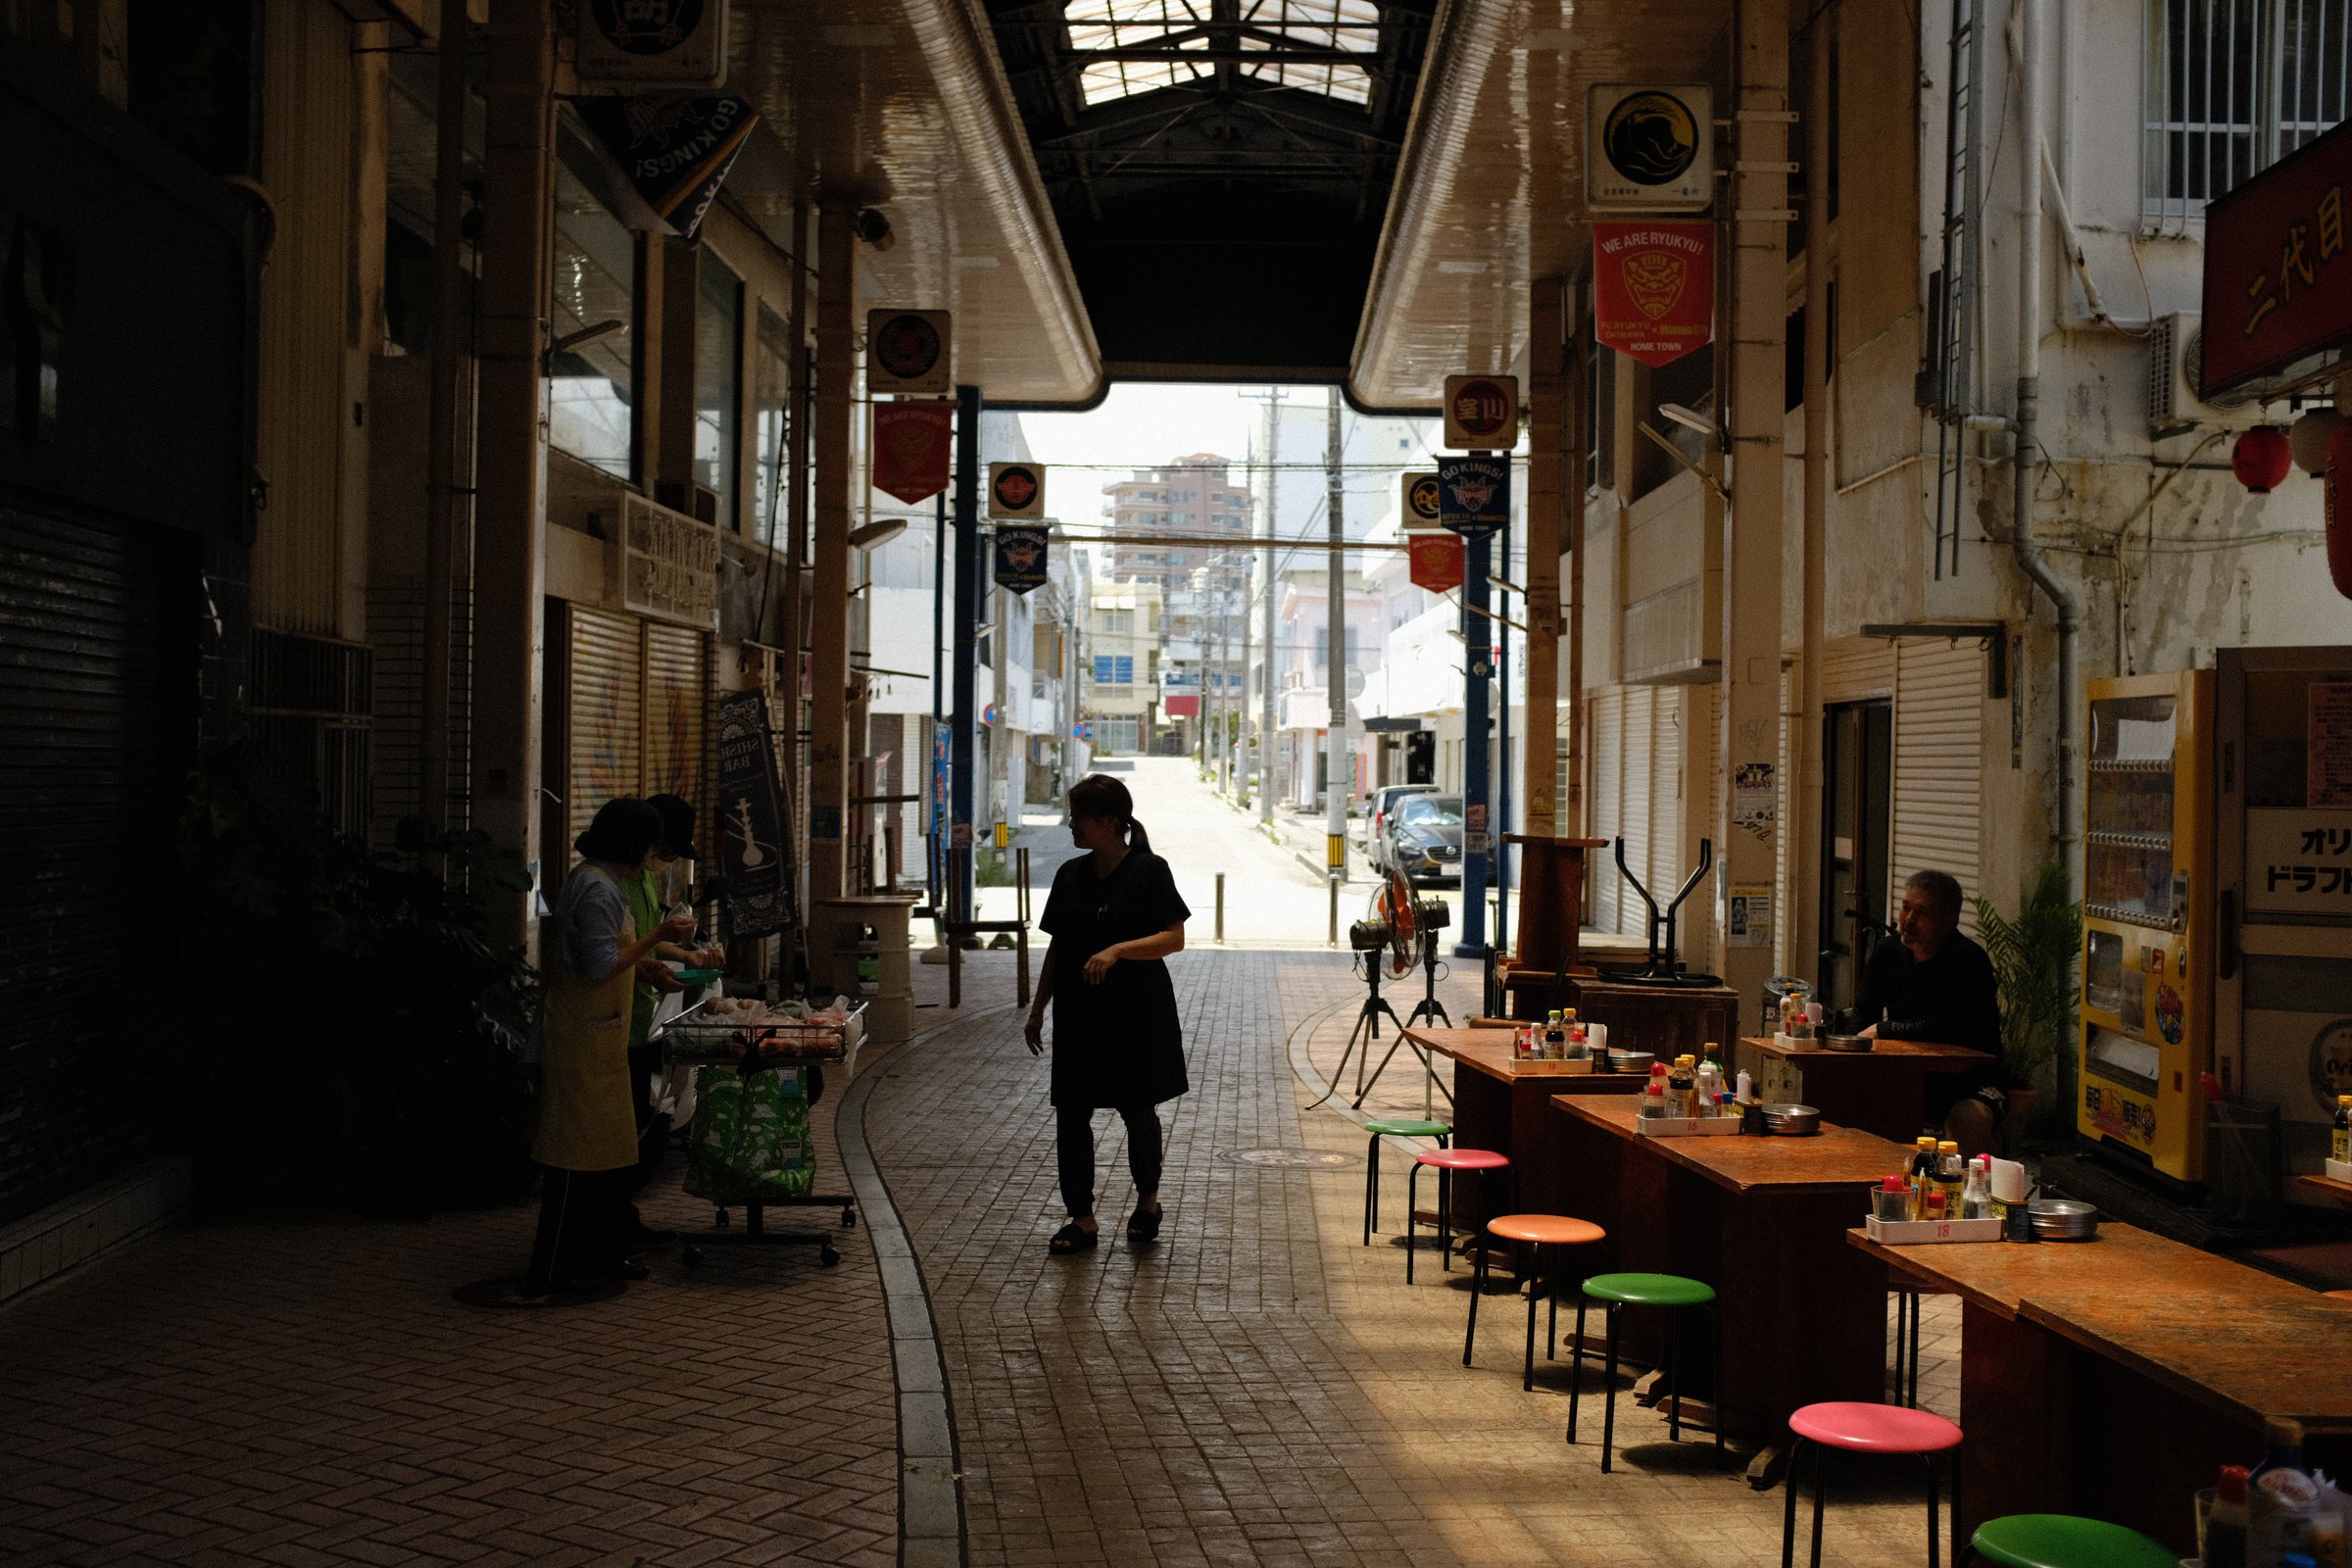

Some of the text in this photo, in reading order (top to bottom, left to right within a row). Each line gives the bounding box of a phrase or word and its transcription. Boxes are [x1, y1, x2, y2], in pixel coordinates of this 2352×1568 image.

[710, 98, 738, 131] GO
[1601, 231, 1705, 255] WE ARE RYUKYU!
[2244, 185, 2344, 336] 二代目
[1630, 342, 1682, 352] HOME TOWN
[1456, 397, 1505, 421] 室川
[1441, 462, 1504, 480] GO KINGS!
[998, 533, 1012, 545] GO
[2300, 828, 2351, 856] オリ
[1687, 1121, 1697, 1131] 16
[1936, 1225, 1950, 1238] 18
